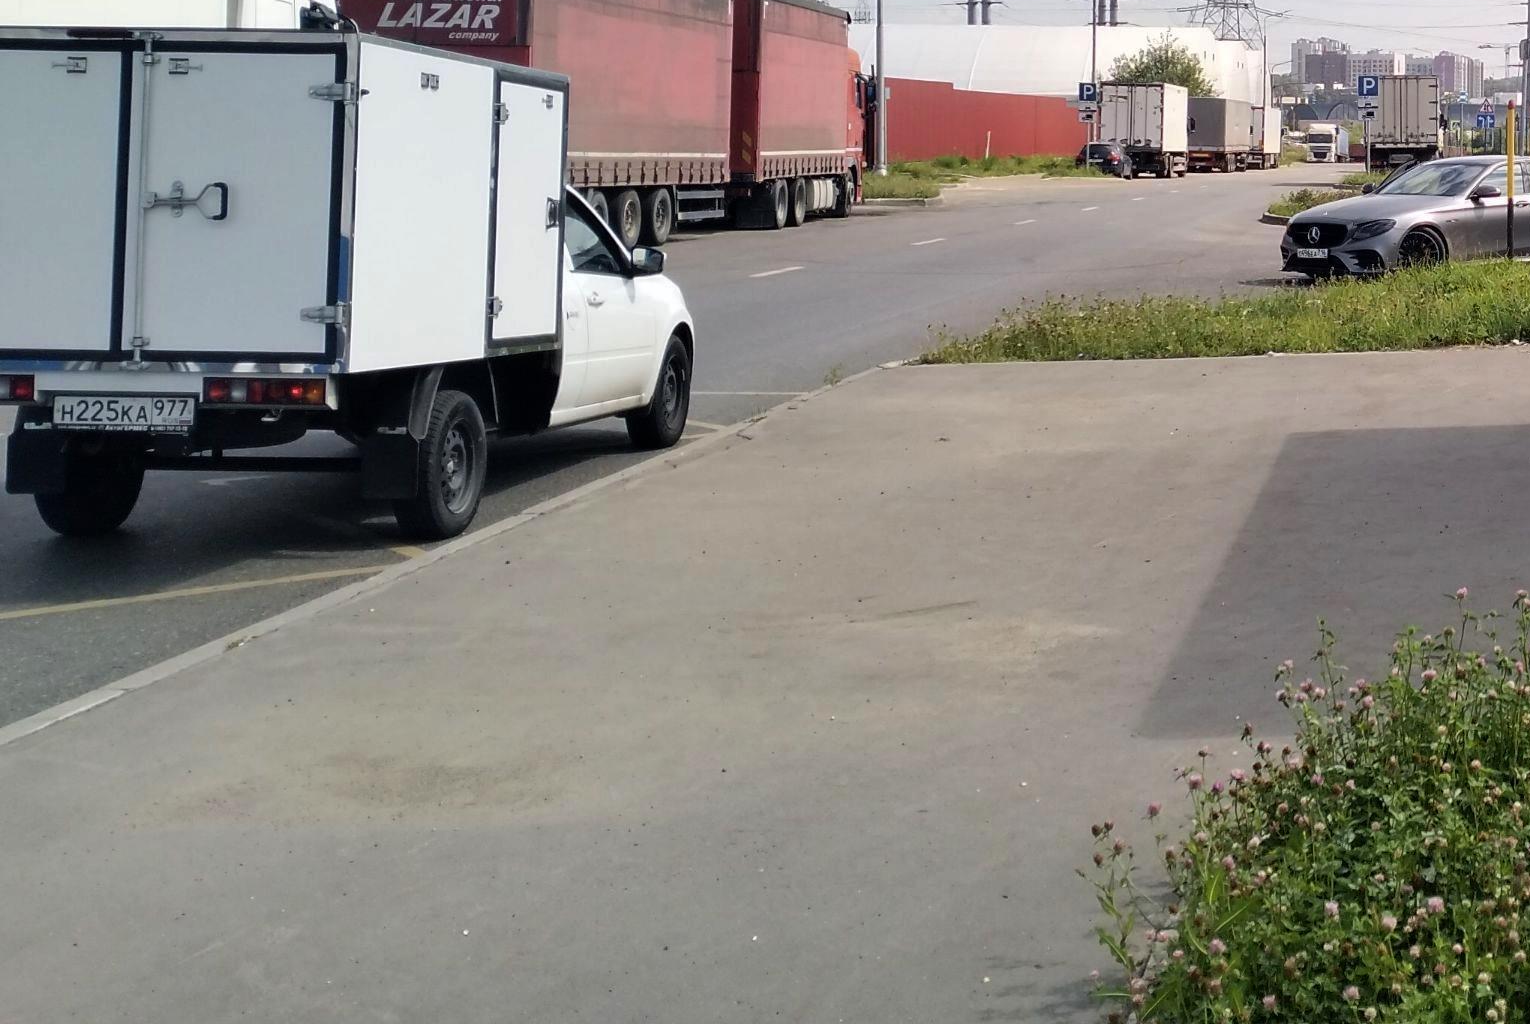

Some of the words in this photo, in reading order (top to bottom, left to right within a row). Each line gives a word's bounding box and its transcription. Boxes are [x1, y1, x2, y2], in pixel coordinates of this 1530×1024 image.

[377, 2, 500, 29] LAZAR
[448, 31, 500, 42] company
[154, 399, 189, 417] 977
